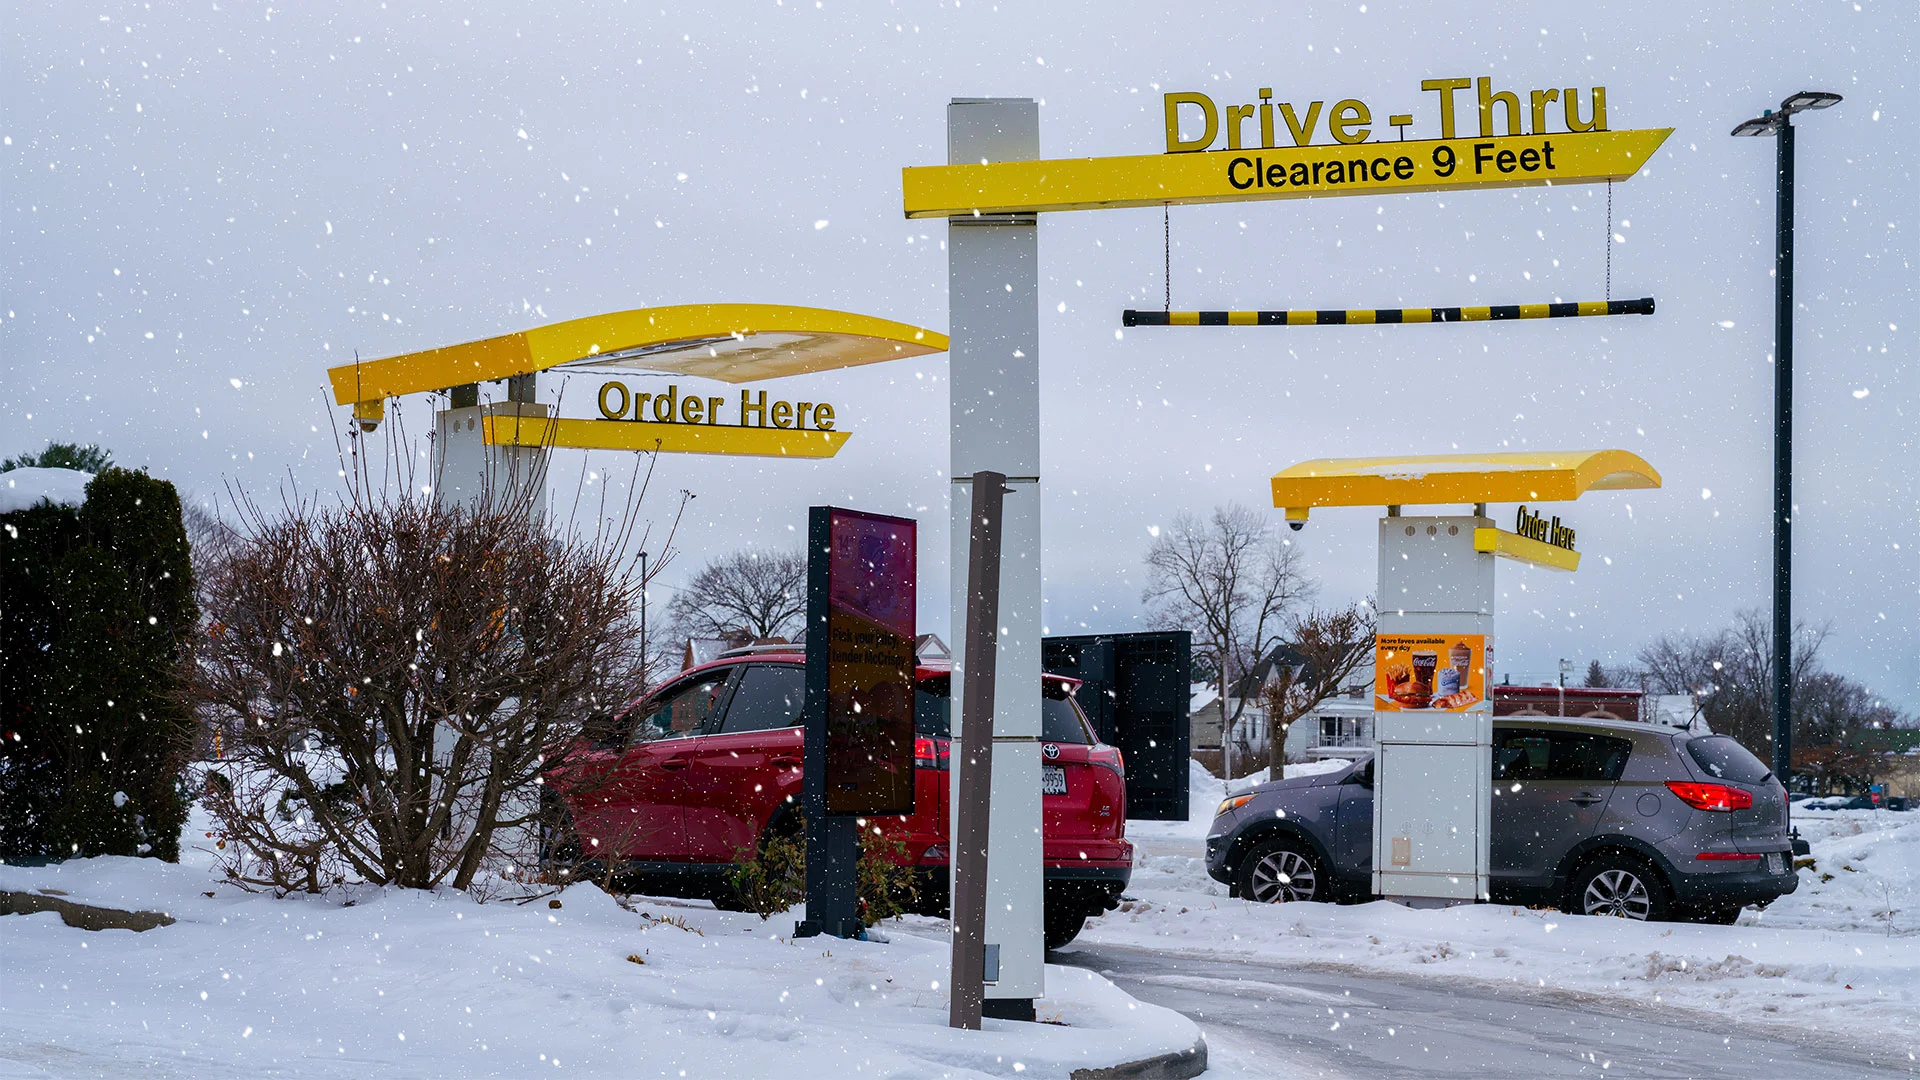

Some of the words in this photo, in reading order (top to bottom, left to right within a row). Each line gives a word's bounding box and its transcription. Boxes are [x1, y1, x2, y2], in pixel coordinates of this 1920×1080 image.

[1227, 154, 1414, 190] Clearance
[1432, 147, 1456, 177] 9
[1474, 141, 1555, 175] Feet
[598, 381, 725, 425] Order
[741, 389, 836, 431] Here
[1516, 504, 1549, 543] Order
[1550, 515, 1576, 552] Here
[854, 631, 874, 646] your
